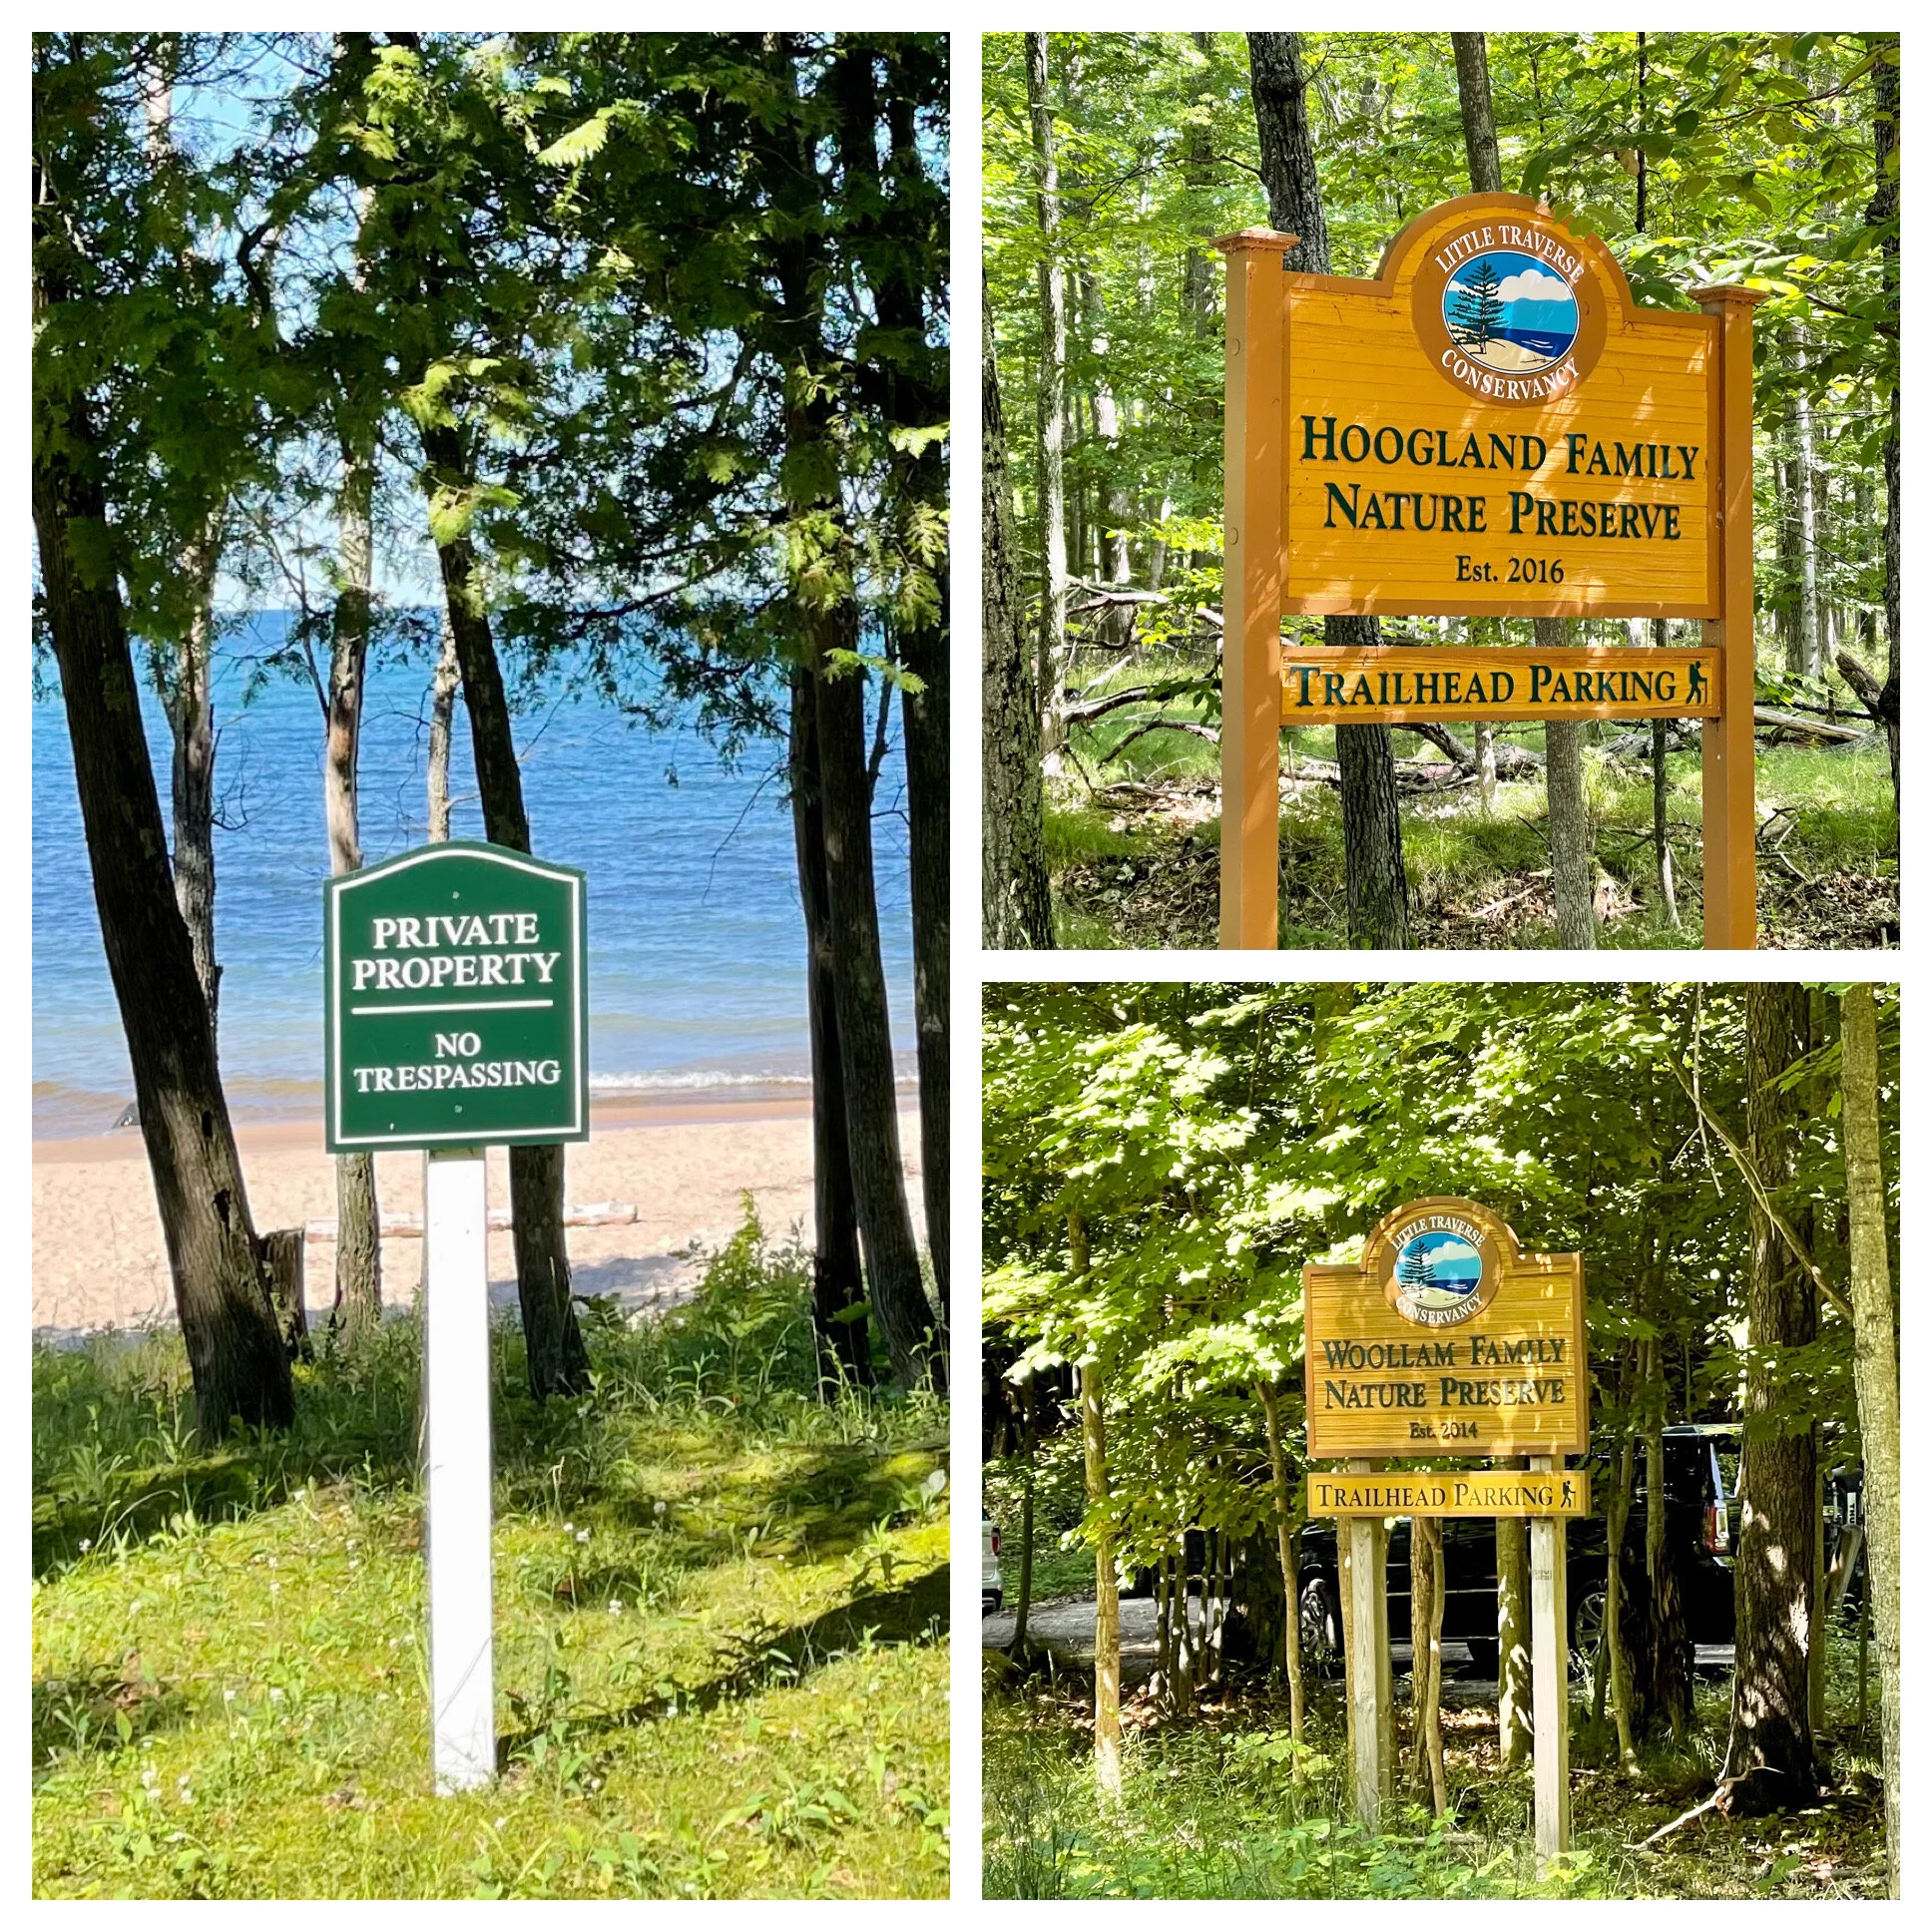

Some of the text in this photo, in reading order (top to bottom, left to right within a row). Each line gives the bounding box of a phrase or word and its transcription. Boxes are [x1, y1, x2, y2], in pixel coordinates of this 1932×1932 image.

[1435, 225, 1585, 284] LITTLE TRAVERSE
[1441, 348, 1580, 400] CONSERVANCY
[1300, 415, 1699, 481] HOOGLAND FAMILY
[1323, 482, 1682, 541] NATURE PRESERVE
[1455, 555, 1565, 585] Est. 2016
[1289, 665, 1677, 708] TRAILHEAD PARKING
[372, 913, 540, 949] PRIVATE
[351, 952, 561, 990] PROPERTY
[435, 1032, 481, 1058] NO
[353, 1060, 562, 1093] TRESPASSING
[1390, 1215, 1486, 1250] LITTLE TRAVERSE
[1395, 1293, 1483, 1324] CONSERVANCY
[1322, 1335, 1566, 1371] WOOLLAM FAMILY
[1324, 1377, 1566, 1410] NATURE PRESERVE
[1410, 1421, 1478, 1439] Est. 2014
[1316, 1483, 1553, 1507] TRAILHEAD PARKING
